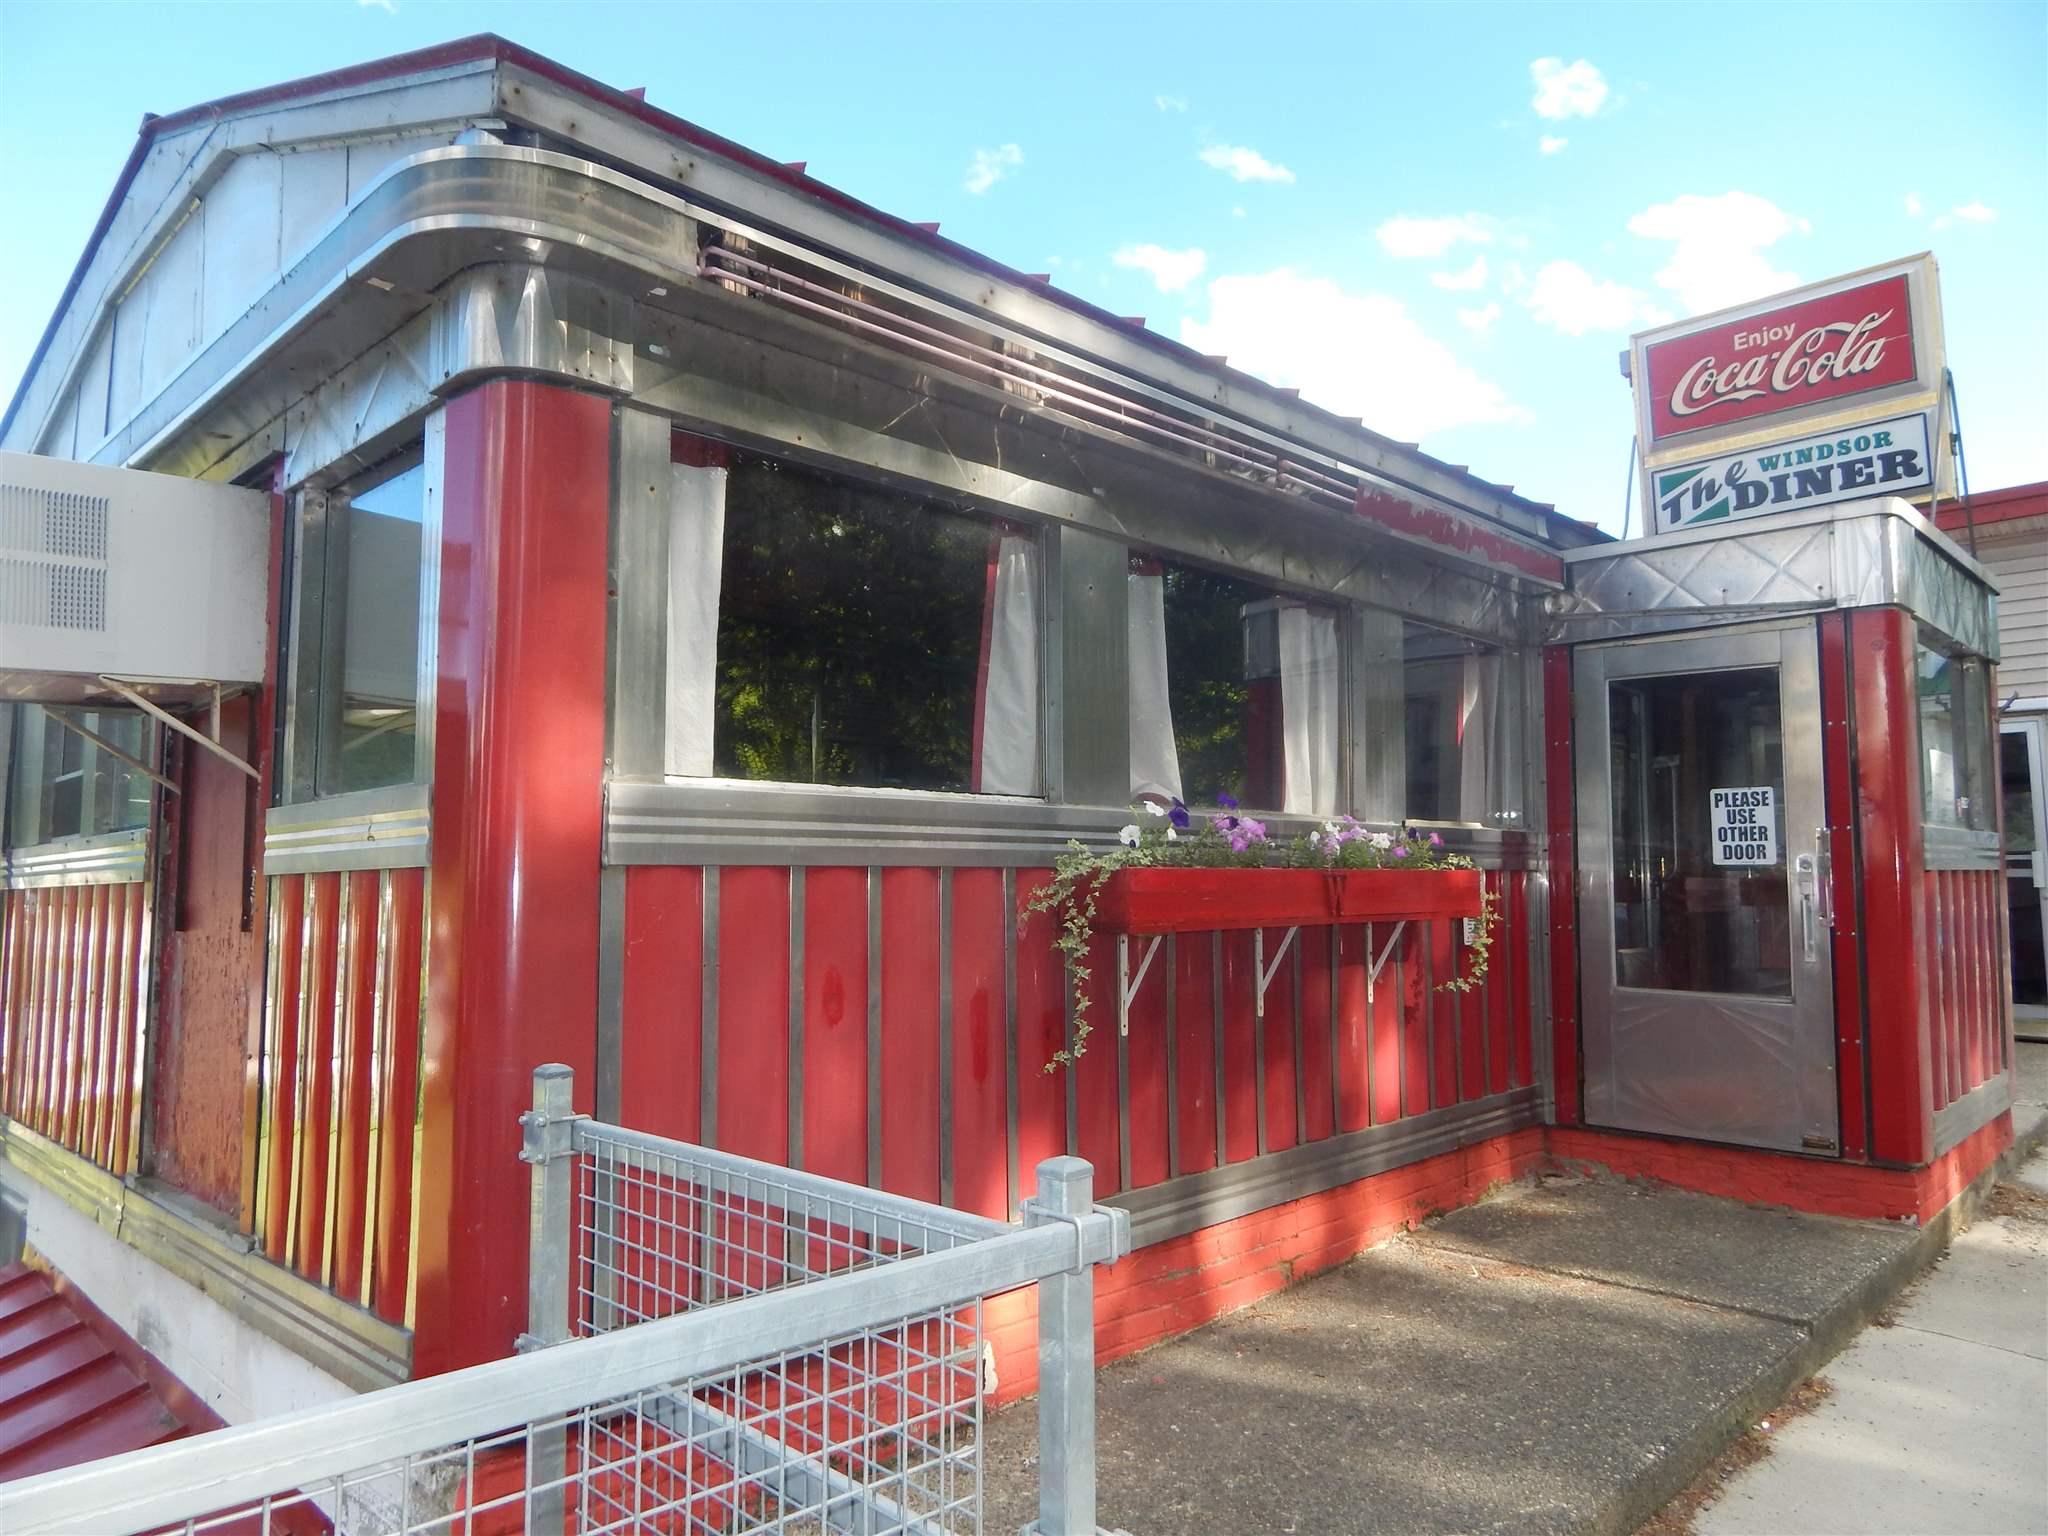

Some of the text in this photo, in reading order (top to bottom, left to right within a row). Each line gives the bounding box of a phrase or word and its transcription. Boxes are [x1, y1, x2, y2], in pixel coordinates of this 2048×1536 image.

[1733, 322, 1797, 351] Enjoy
[1670, 308, 1894, 417] Coca-Cola
[1661, 430, 1894, 525] The WINDSOR
[1732, 448, 1924, 512] DINER
[1713, 790, 1770, 808] PLEASE
[1726, 808, 1757, 825] USE
[1717, 826, 1769, 842] OTHER
[1722, 843, 1767, 860] DOOR
